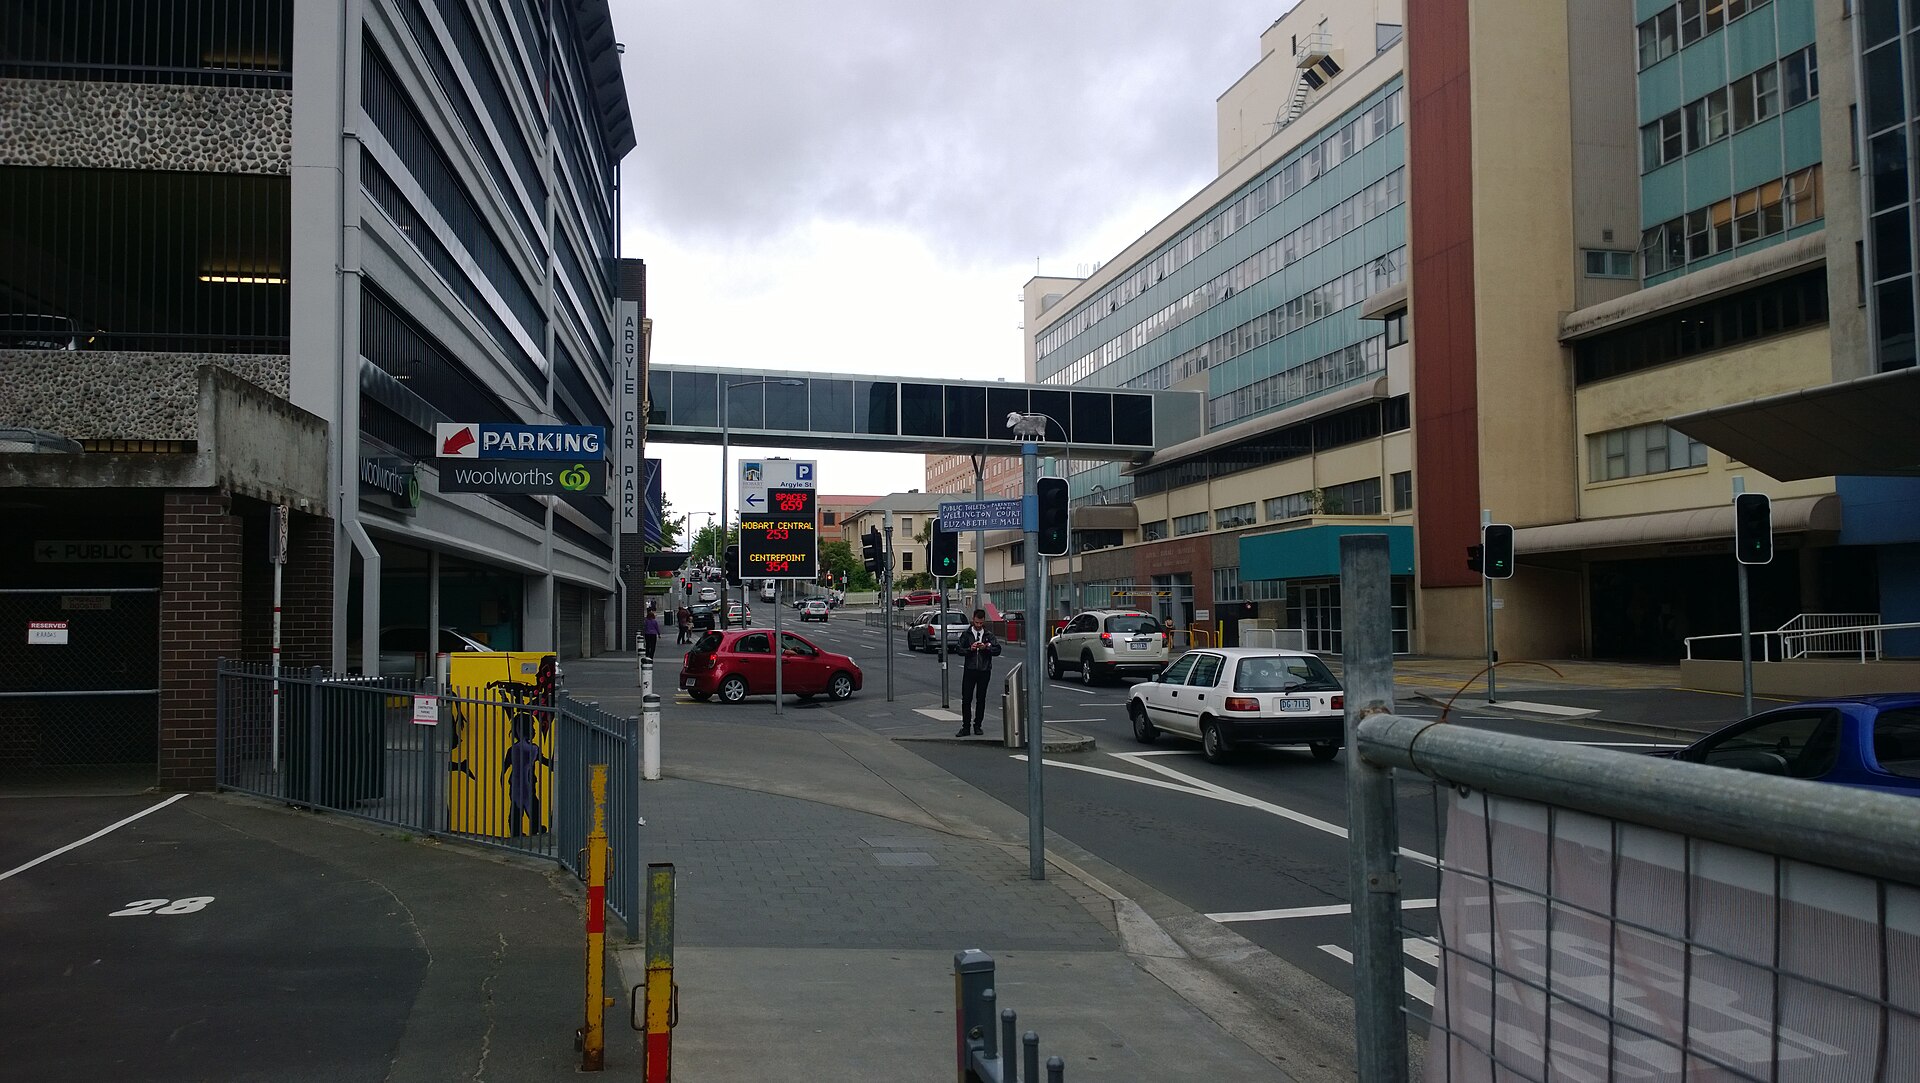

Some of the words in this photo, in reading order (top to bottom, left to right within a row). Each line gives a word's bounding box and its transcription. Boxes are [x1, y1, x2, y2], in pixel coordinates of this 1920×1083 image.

[624, 316, 635, 395] ARGYLE
[624, 411, 635, 449] CAR
[482, 430, 599, 454] PARKING
[360, 455, 404, 496] Woolworths
[455, 466, 554, 486] Woolworths
[624, 465, 635, 518] PARK
[775, 493, 808, 501] SPACES
[780, 501, 804, 511] 659
[943, 504, 962, 512] PUBLIC
[965, 503, 986, 511] TOILETS
[944, 511, 992, 519] WELLINGTON
[996, 510, 1021, 518] COURT
[742, 521, 775, 530] HOBART
[777, 521, 814, 530] CENTRAL
[944, 519, 987, 528] ELIZABETH
[766, 530, 789, 540] 253
[65, 544, 133, 560] PUBLIC
[749, 554, 806, 562] CENTREPOINT
[765, 562, 789, 572] 354
[1281, 700, 1292, 709] DG
[1293, 700, 1310, 709] 7113
[107, 896, 216, 917] 28
